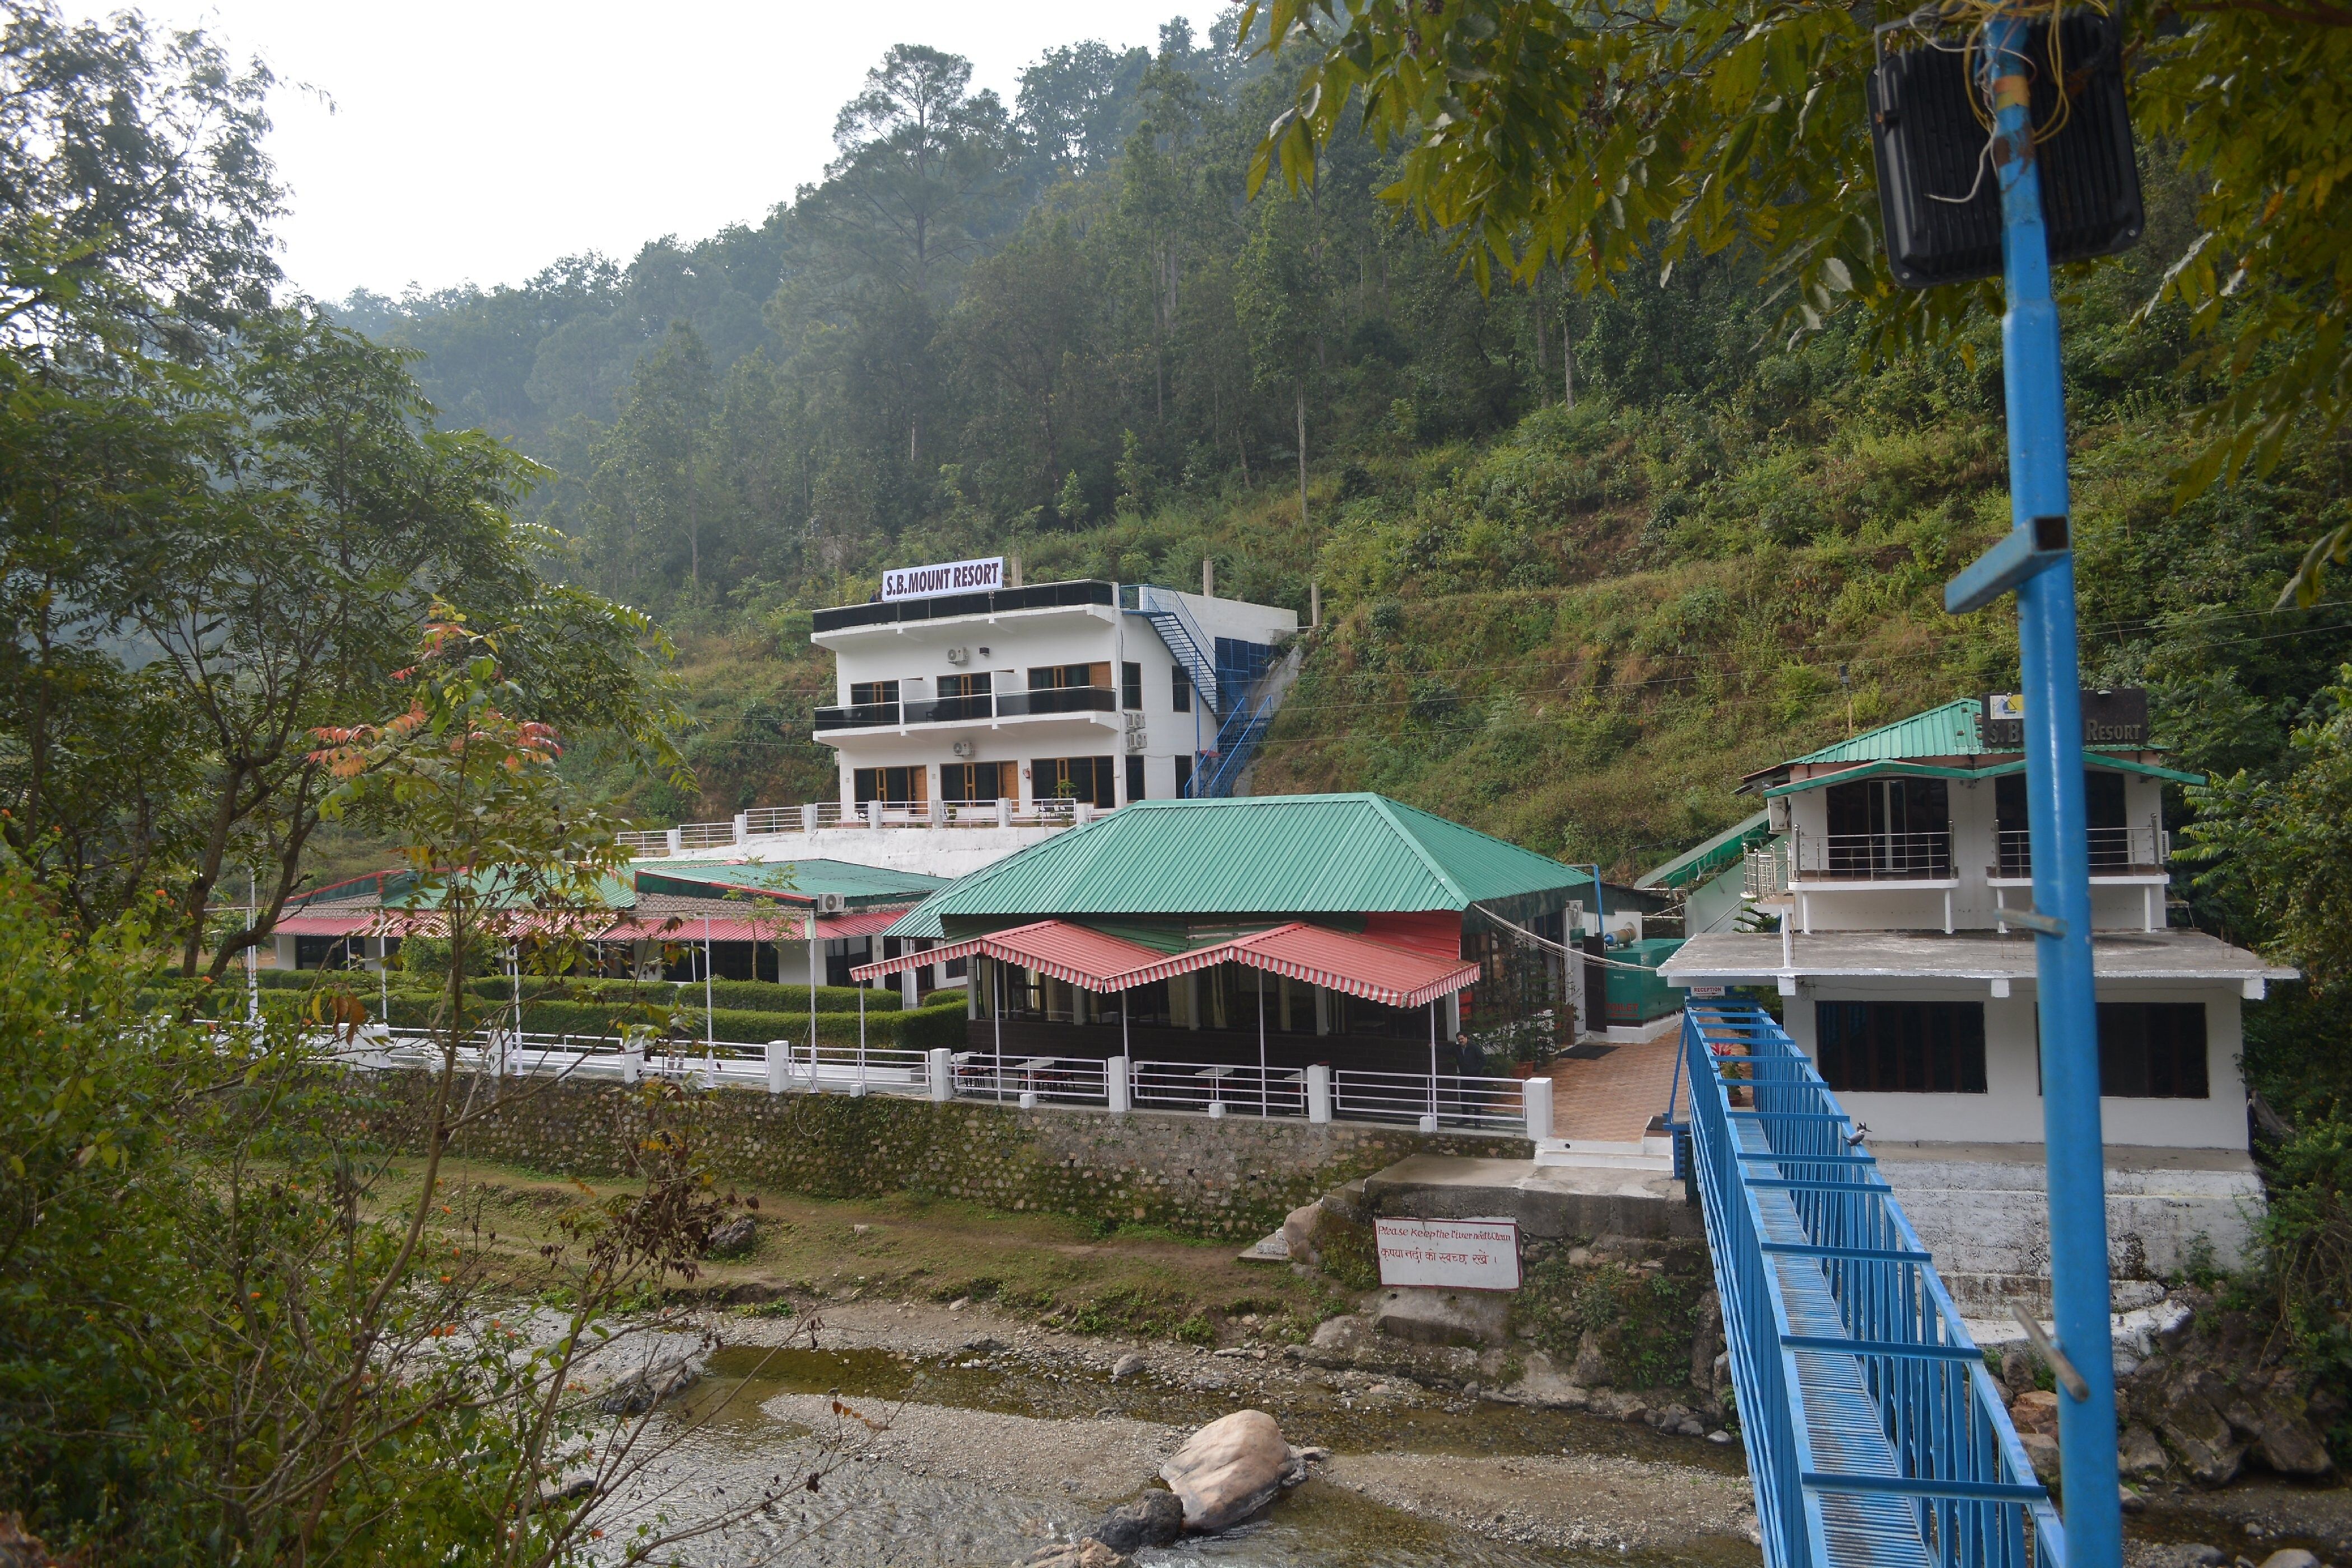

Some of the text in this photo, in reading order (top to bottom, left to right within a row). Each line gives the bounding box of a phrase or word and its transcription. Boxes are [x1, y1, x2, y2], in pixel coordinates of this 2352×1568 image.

[953, 563, 999, 588] RESORT
[1605, 1003, 1638, 1012] TOILET
[1378, 1226, 1408, 1236] Please
[1436, 1229, 1450, 1239] the
